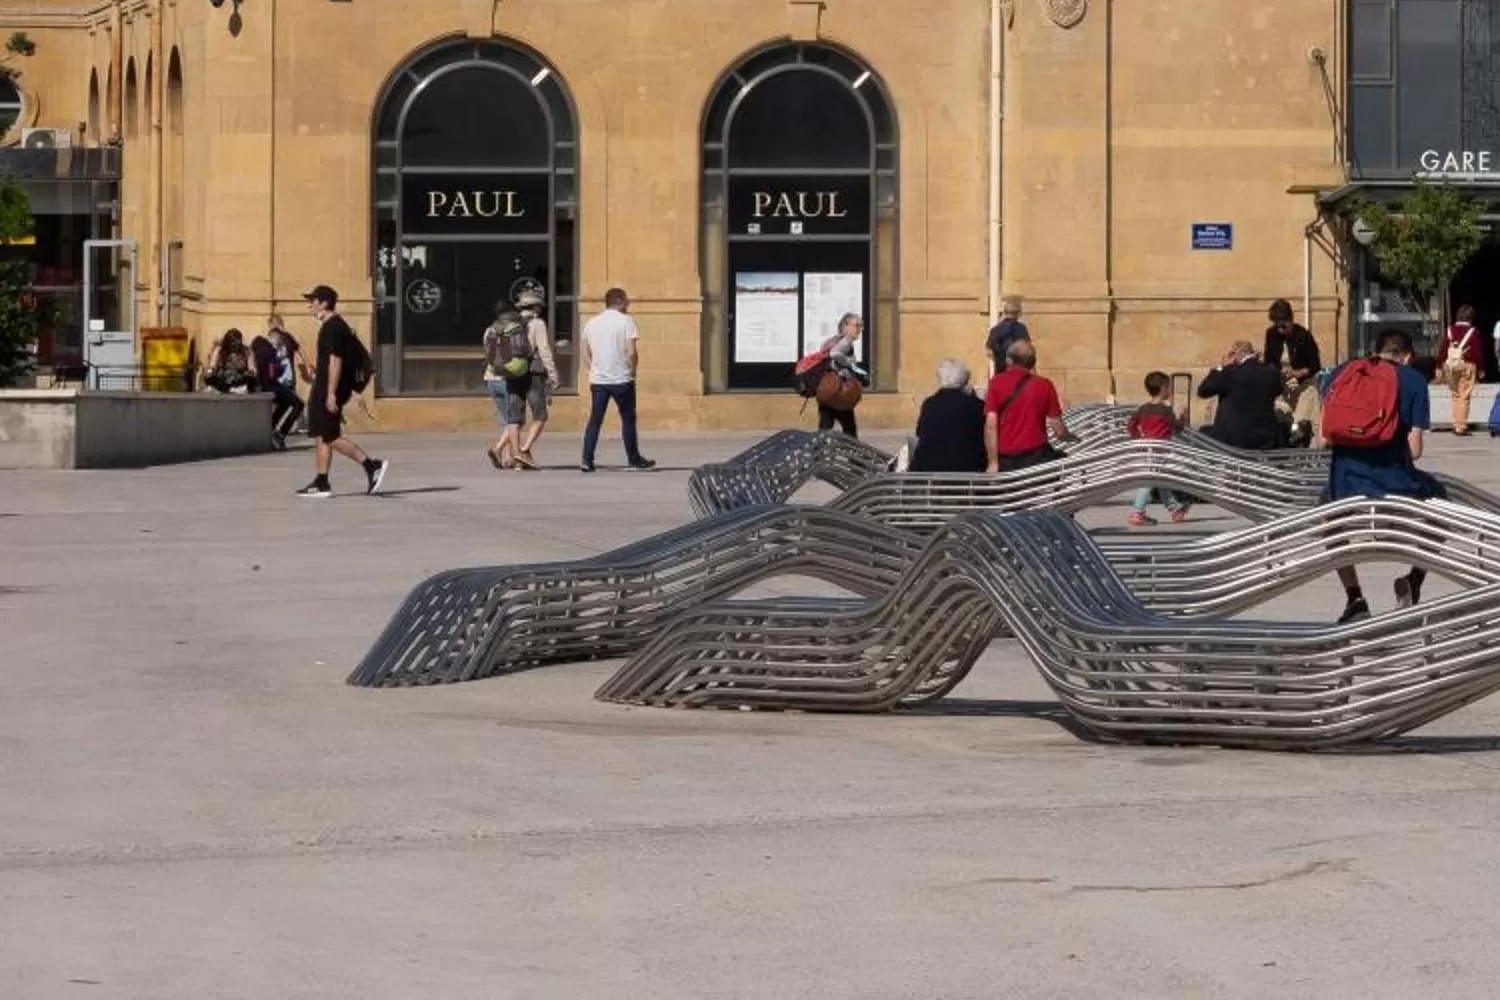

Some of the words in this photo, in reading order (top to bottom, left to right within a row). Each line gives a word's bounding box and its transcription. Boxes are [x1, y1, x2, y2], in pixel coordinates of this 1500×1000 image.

[1420, 149, 1490, 172] GARE
[425, 191, 525, 217] PAUL
[752, 191, 847, 217] PAUL
